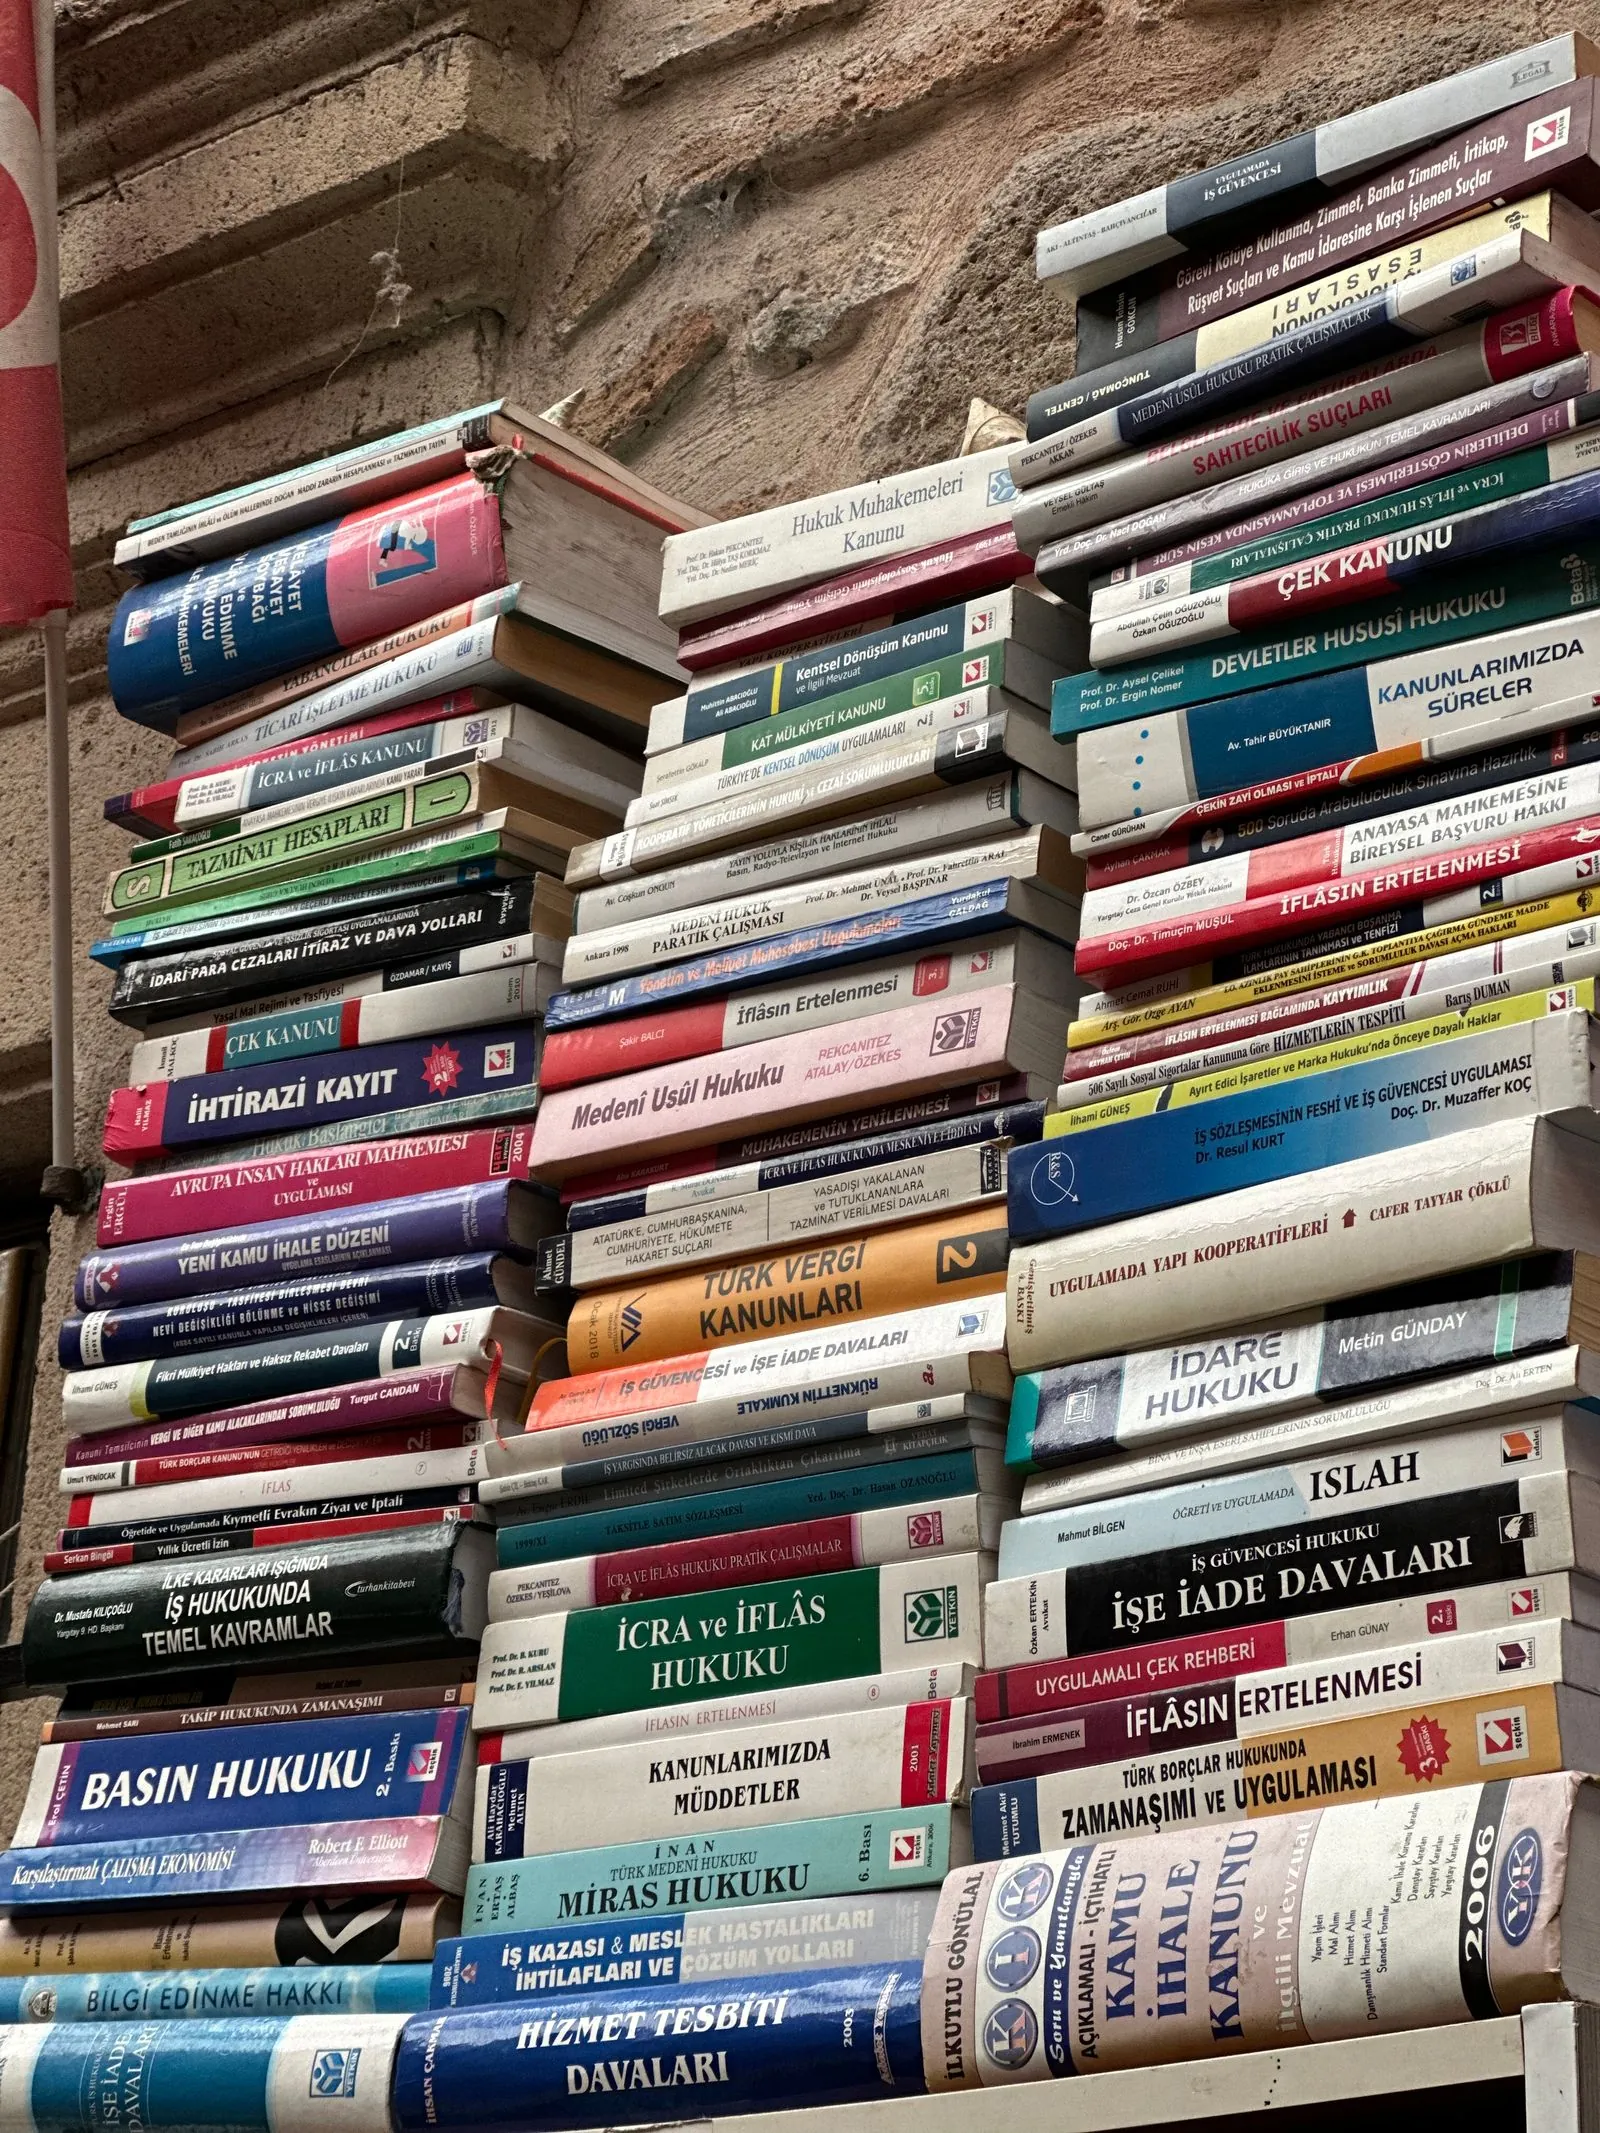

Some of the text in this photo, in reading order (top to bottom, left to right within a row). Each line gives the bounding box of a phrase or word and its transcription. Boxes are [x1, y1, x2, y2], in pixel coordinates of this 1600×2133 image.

[1176, 133, 1509, 289] Görevi Kötüye Kullanma, Zimmet, Banka Zimmeti, İrtikap,
[1188, 169, 1493, 315] Rüşvet Suçları ve Kamu İdaresine Karşı İşlenen Suçlar
[1193, 387, 1392, 474] SAHTECİLİK SUÇLARI
[793, 471, 963, 536] Hukuk Muhakemeleri
[843, 523, 904, 553] Kanunu
[1278, 523, 1454, 601] ÇEK KANUNU
[796, 624, 948, 682] Kentsel Dönüşüm Kanunu
[1212, 587, 1505, 678] DEVLETLER HUSUSÎ HUKUKU
[1377, 638, 1584, 705] KANUNLARIMIZDA
[1428, 678, 1533, 718] SÜRELER
[1227, 718, 1331, 752] Av. Tahir BÜYÜKTANIR
[258, 738, 426, 789] İCRA ve İFLÂS KANUNU
[187, 841, 277, 880] TAZMİNAT
[284, 805, 391, 852] HESAPLARI
[1281, 843, 1521, 916] İFLÂSIN ERTELENMESİ
[149, 909, 482, 988] İDARİ PARA CEZALARI İTİRAZ VE DAVA YOLLARI
[737, 976, 898, 1026] İflâsın Ertelenmesi
[225, 1015, 339, 1057] ÇEK KANUNU
[188, 1068, 398, 1124] İHTİRAZİ KAYIT
[571, 1063, 784, 1130] Medenî Usûl Hukuku
[1194, 1053, 1532, 1147] İŞ SÖZLEŞMESİNİN FESHİ VE İŞ GÜVENCESİ UYGULAMASI
[1391, 1075, 1533, 1121] Doç. Dr. Muzaffer KOÇ
[1196, 1132, 1284, 1164] Dr. Resul KURT
[178, 1220, 389, 1276] YENİ KAMU İHALE DÜZENİ
[1049, 1176, 1511, 1298] UYGULAMADA YAPI KOOPERATİFLERİ CAFER TAYYAR ÇÖKLÜ
[703, 1242, 865, 1299] TÜRK VERGİ
[701, 1280, 862, 1339] KANUNLARI
[1339, 1312, 1467, 1355] Metin GÜNDAY
[156, 1341, 368, 1382] Fikri Mülkiyet Hakları ve Haksız Rekabet Davaları
[1169, 1330, 1282, 1374] İDARE
[1145, 1363, 1298, 1419] HUKUKU
[1309, 1452, 1419, 1502] ISLAH
[223, 1495, 402, 1527] Kıymetli Evrakın Ziyaı ve İptali
[157, 1536, 229, 1556] Yıllık Ücretli İzin
[1192, 1522, 1380, 1574] İŞ GÜVENCESİ HUKUKU
[165, 1580, 310, 1622] İŞ HUKUKUNDA
[1111, 1536, 1472, 1634] İŞE İADE DAVALARI
[142, 1611, 333, 1657] TEMEL KAVRAMLAR
[616, 1589, 826, 1651] İCRA ve İFLÂS
[651, 1645, 788, 1690] HUKUKU
[1036, 1638, 1256, 1698] UYGULAMALI ÇEK REHBERİ
[1126, 1658, 1422, 1738] İFLÂSIN ERTELENMESİ
[81, 1747, 371, 1810] BASIN HUKUKU
[649, 1739, 831, 1783] KANUNLARIMIZDA
[1123, 1740, 1306, 1789] TÜRK BORÇLAR HUKUKUNDA
[675, 1778, 801, 1815] MÜDDETLER
[1062, 1756, 1376, 1840] ZAMANAŞIMI VE UYGULAMASI
[558, 1863, 809, 1918] MİRAS HUKUKU
[1463, 1825, 1495, 1961] 2006
[502, 1927, 712, 1969] İŞ KAZASI & MESLEK
[1105, 1871, 1149, 2022] KAMU
[1146, 1859, 1201, 2020] İHALE
[1209, 1830, 1258, 2042] KANUNU
[87, 1981, 342, 2013] BİLGİ EDİNME HAKKI
[516, 1957, 674, 1990] İHTİLAFLARI VE
[943, 1871, 983, 2080] İLKUTLU GÖNÜLAL
[516, 1990, 790, 2050] HİZMET TESBİTİ
[843, 2007, 854, 2047] 2003
[566, 2051, 730, 2095] DAVALARI
